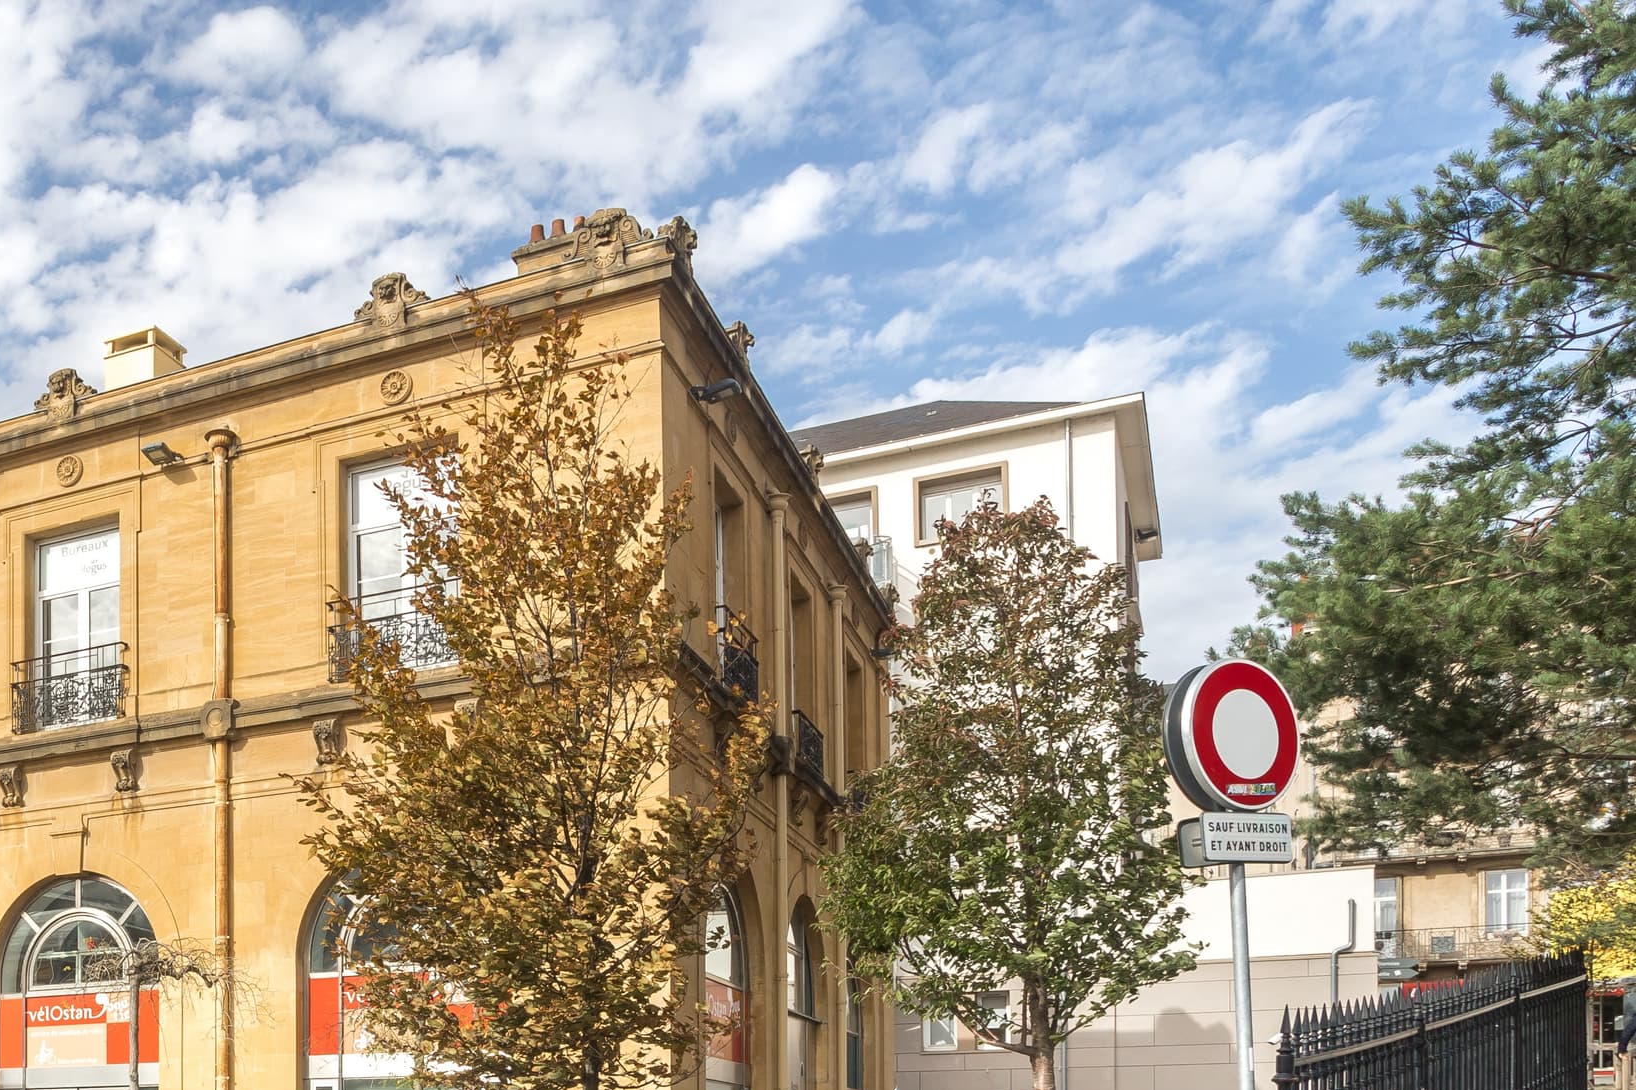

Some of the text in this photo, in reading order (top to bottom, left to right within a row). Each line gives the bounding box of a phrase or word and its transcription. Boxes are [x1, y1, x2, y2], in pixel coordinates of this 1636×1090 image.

[1208, 822, 1288, 834] SAUF LIVRAISON
[1211, 840, 1287, 852] ET AYANT DROIT
[25, 1004, 96, 1023] vélOstan
